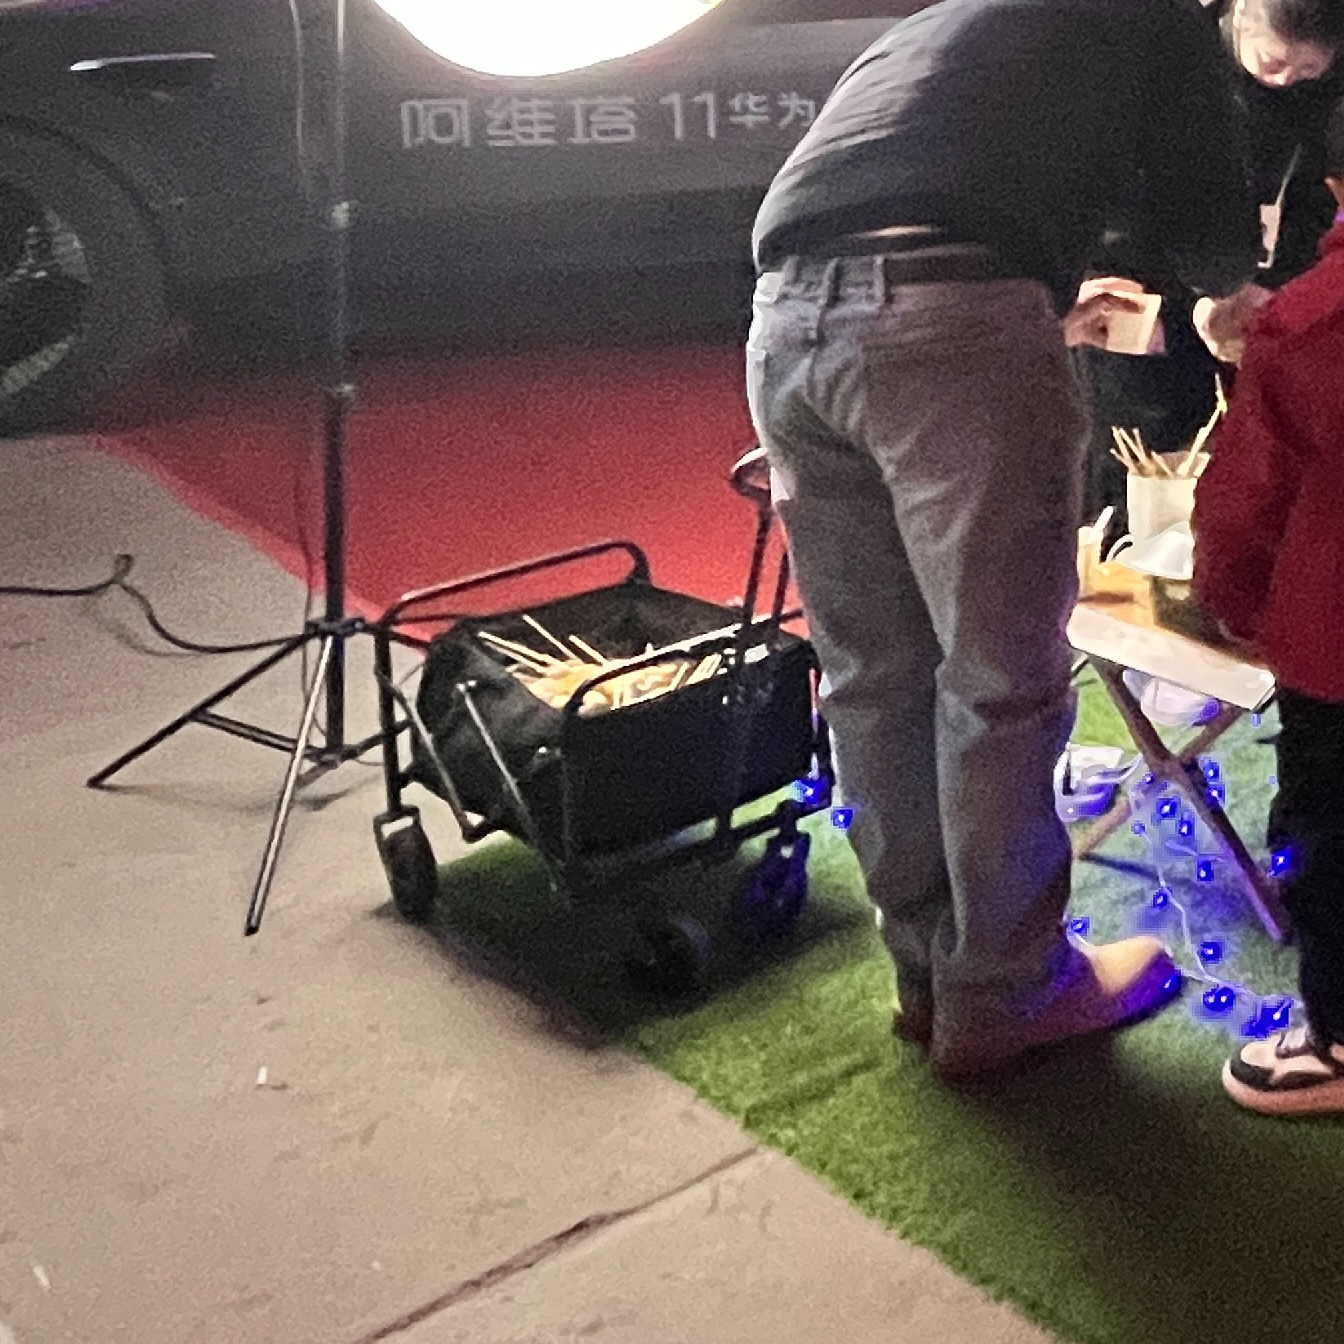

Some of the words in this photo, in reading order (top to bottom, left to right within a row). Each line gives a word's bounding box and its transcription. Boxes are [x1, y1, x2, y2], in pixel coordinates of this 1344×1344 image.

[401, 97, 639, 147] 阿维塔
[658, 93, 717, 141] 11
